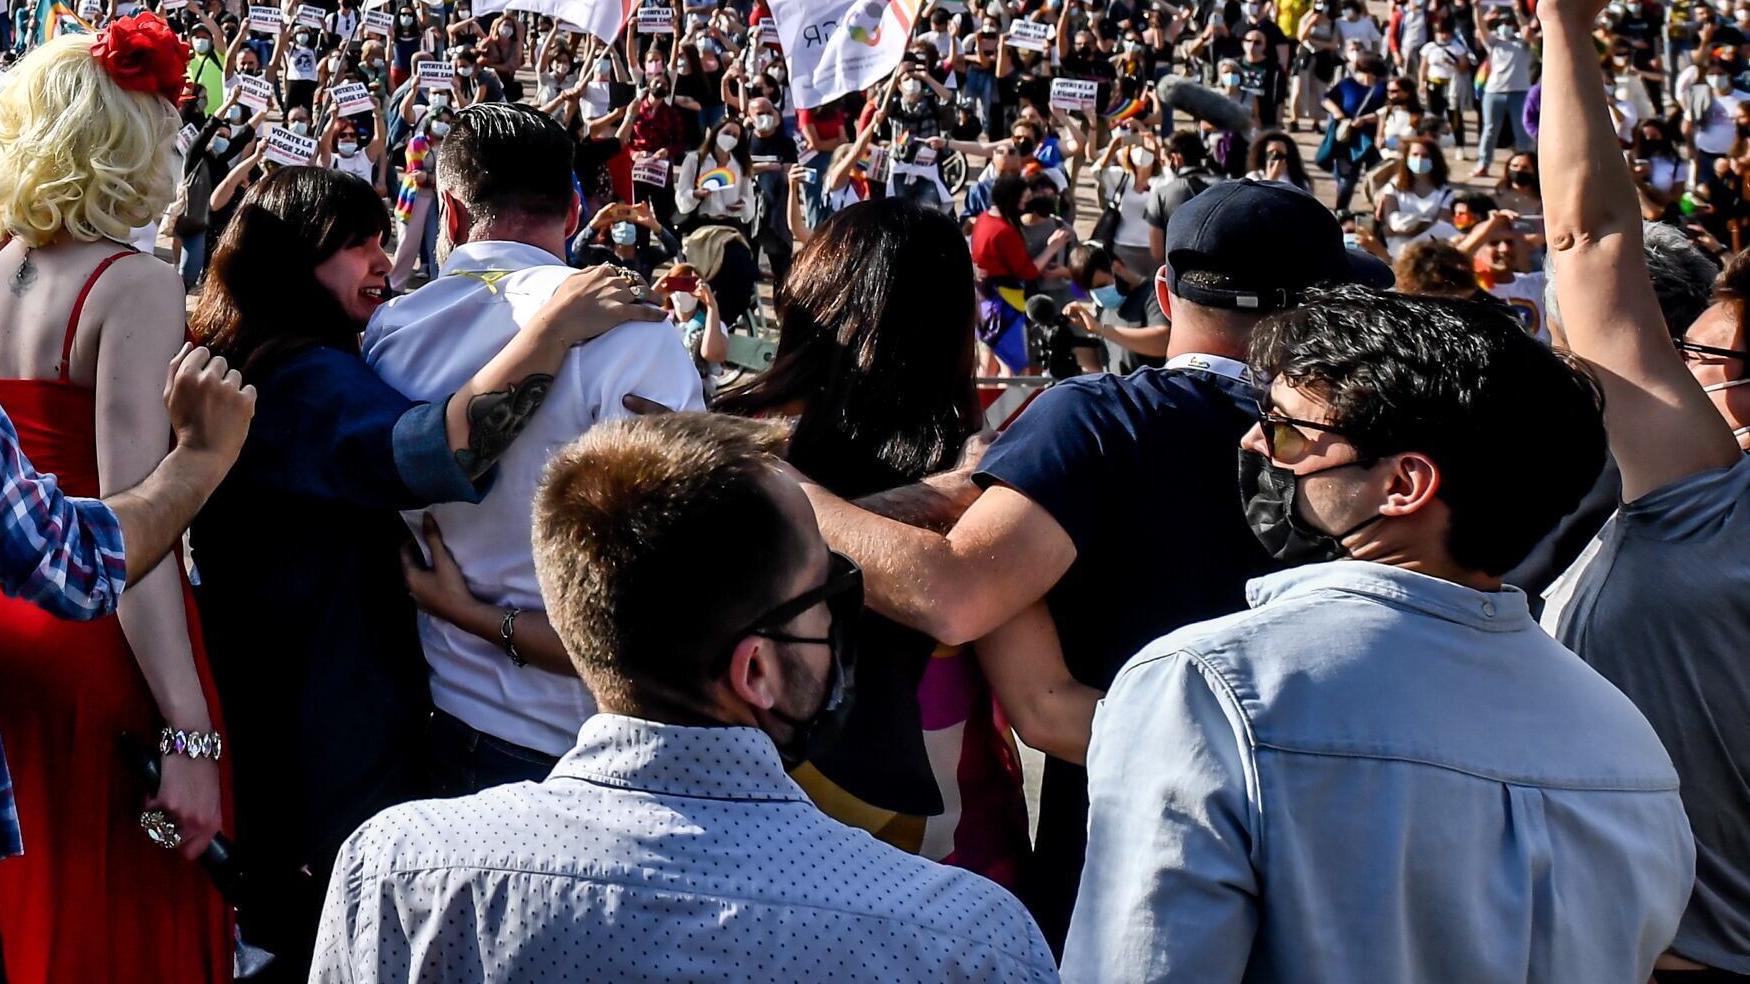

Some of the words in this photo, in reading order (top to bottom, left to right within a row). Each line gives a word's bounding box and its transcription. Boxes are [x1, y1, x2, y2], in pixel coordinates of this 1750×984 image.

[267, 137, 294, 154] LEGGE
[294, 147, 312, 160] ZAN
[272, 127, 301, 144] VOTATE
[302, 138, 313, 149] LA
